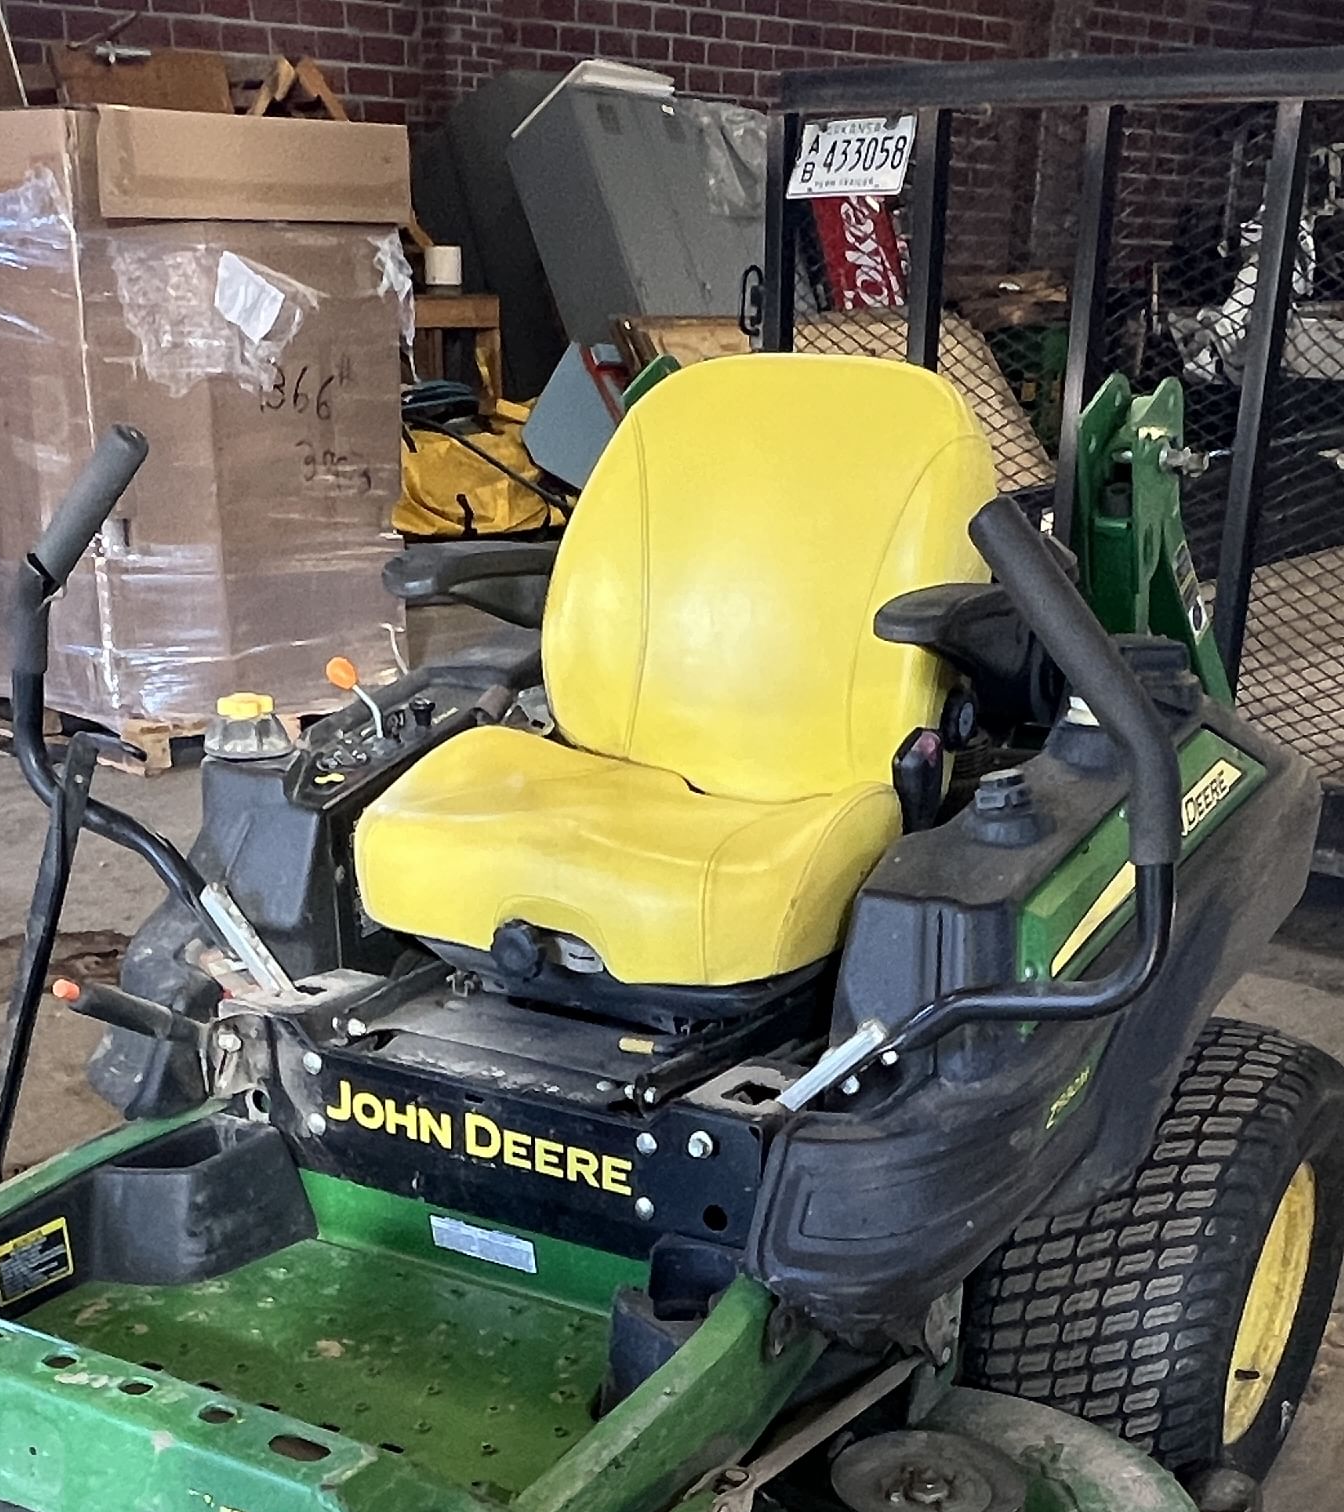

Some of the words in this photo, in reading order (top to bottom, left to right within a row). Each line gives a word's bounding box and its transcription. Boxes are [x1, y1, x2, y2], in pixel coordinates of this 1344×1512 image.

[822, 135, 908, 174] 433058
[1184, 769, 1229, 826] DEERE
[326, 1079, 452, 1150] JOHN
[464, 1111, 633, 1197] DEERE
